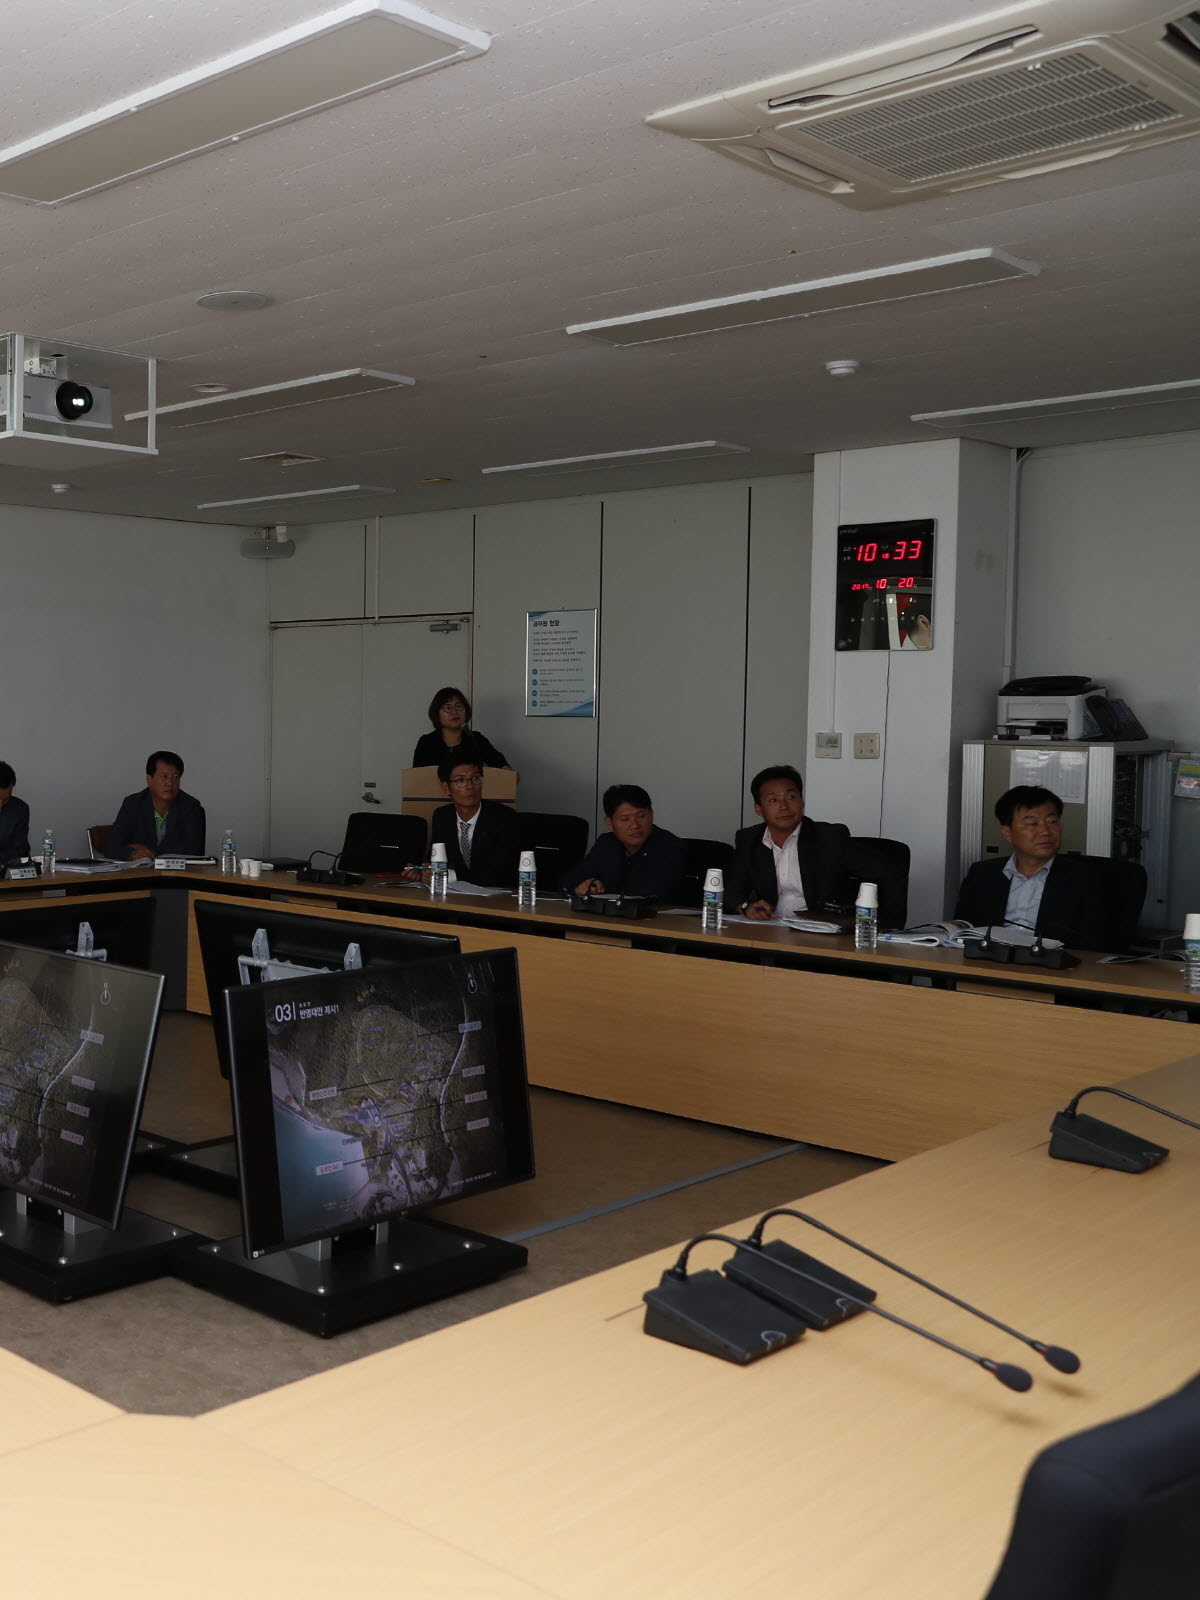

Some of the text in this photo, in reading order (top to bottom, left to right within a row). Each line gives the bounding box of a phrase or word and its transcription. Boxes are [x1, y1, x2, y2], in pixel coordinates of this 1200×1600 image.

[856, 543, 878, 562] 10
[893, 540, 922, 560] 33
[875, 578, 887, 589] 10
[898, 577, 914, 588] 20
[275, 1003, 292, 1023] 03
[299, 1006, 323, 1020] 반영대안
